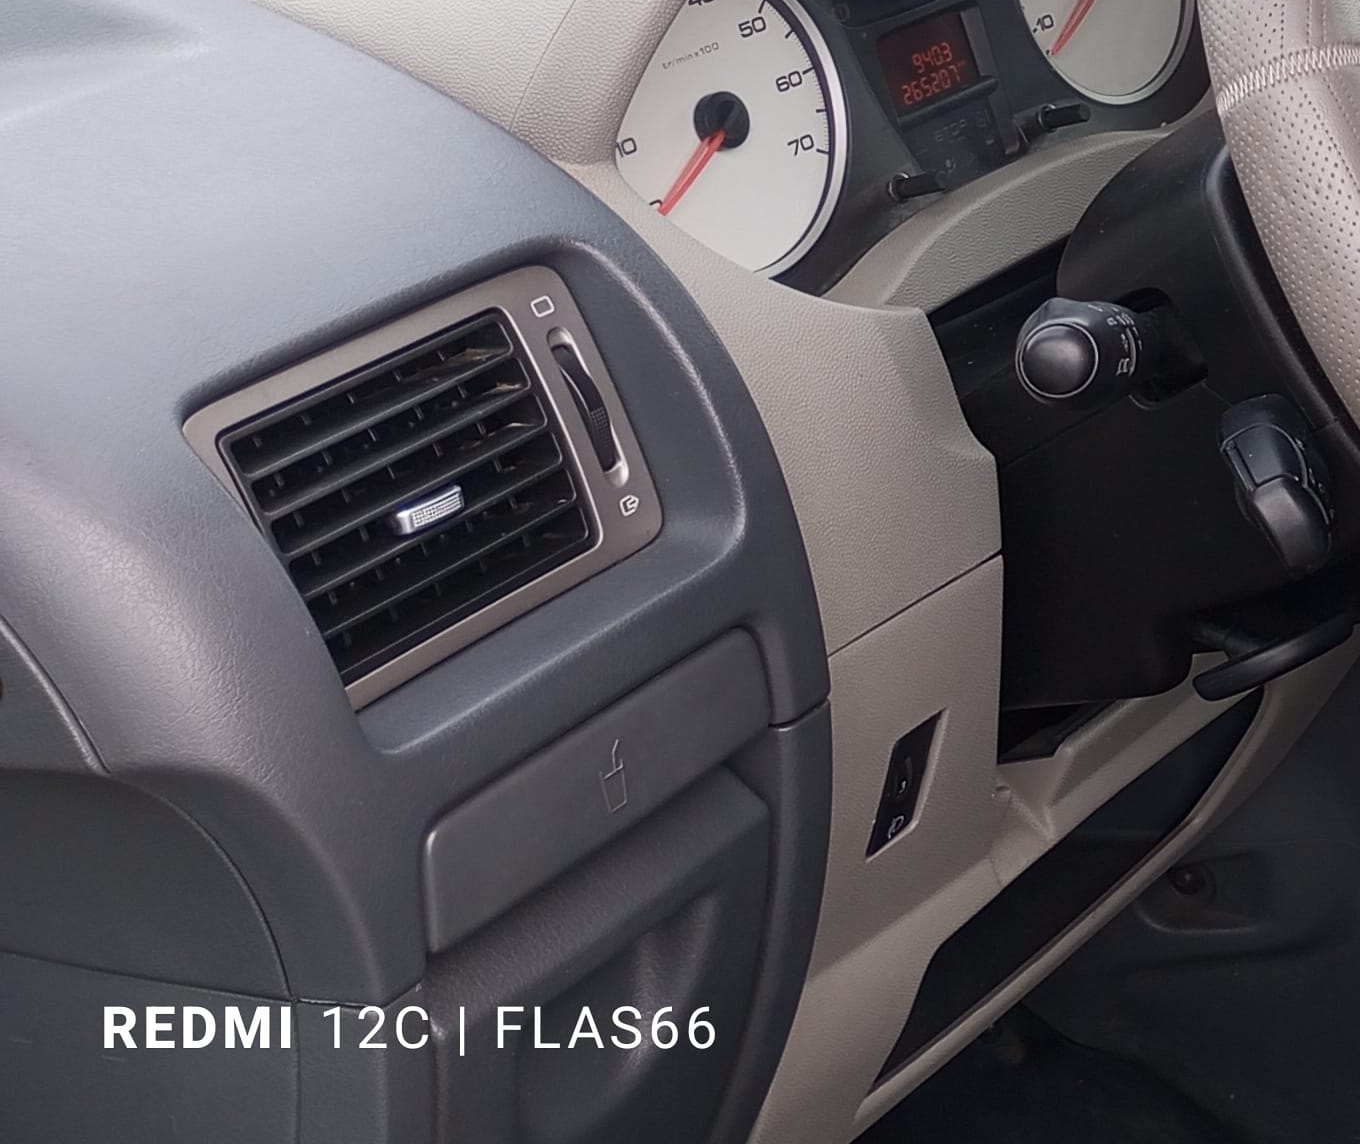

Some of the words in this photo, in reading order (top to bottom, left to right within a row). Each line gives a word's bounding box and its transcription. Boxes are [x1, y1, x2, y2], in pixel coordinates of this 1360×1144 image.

[738, 16, 767, 38] 50
[1036, 14, 1054, 31] 10
[775, 70, 803, 92] 60
[901, 65, 962, 105] 265207
[787, 134, 814, 156] 70
